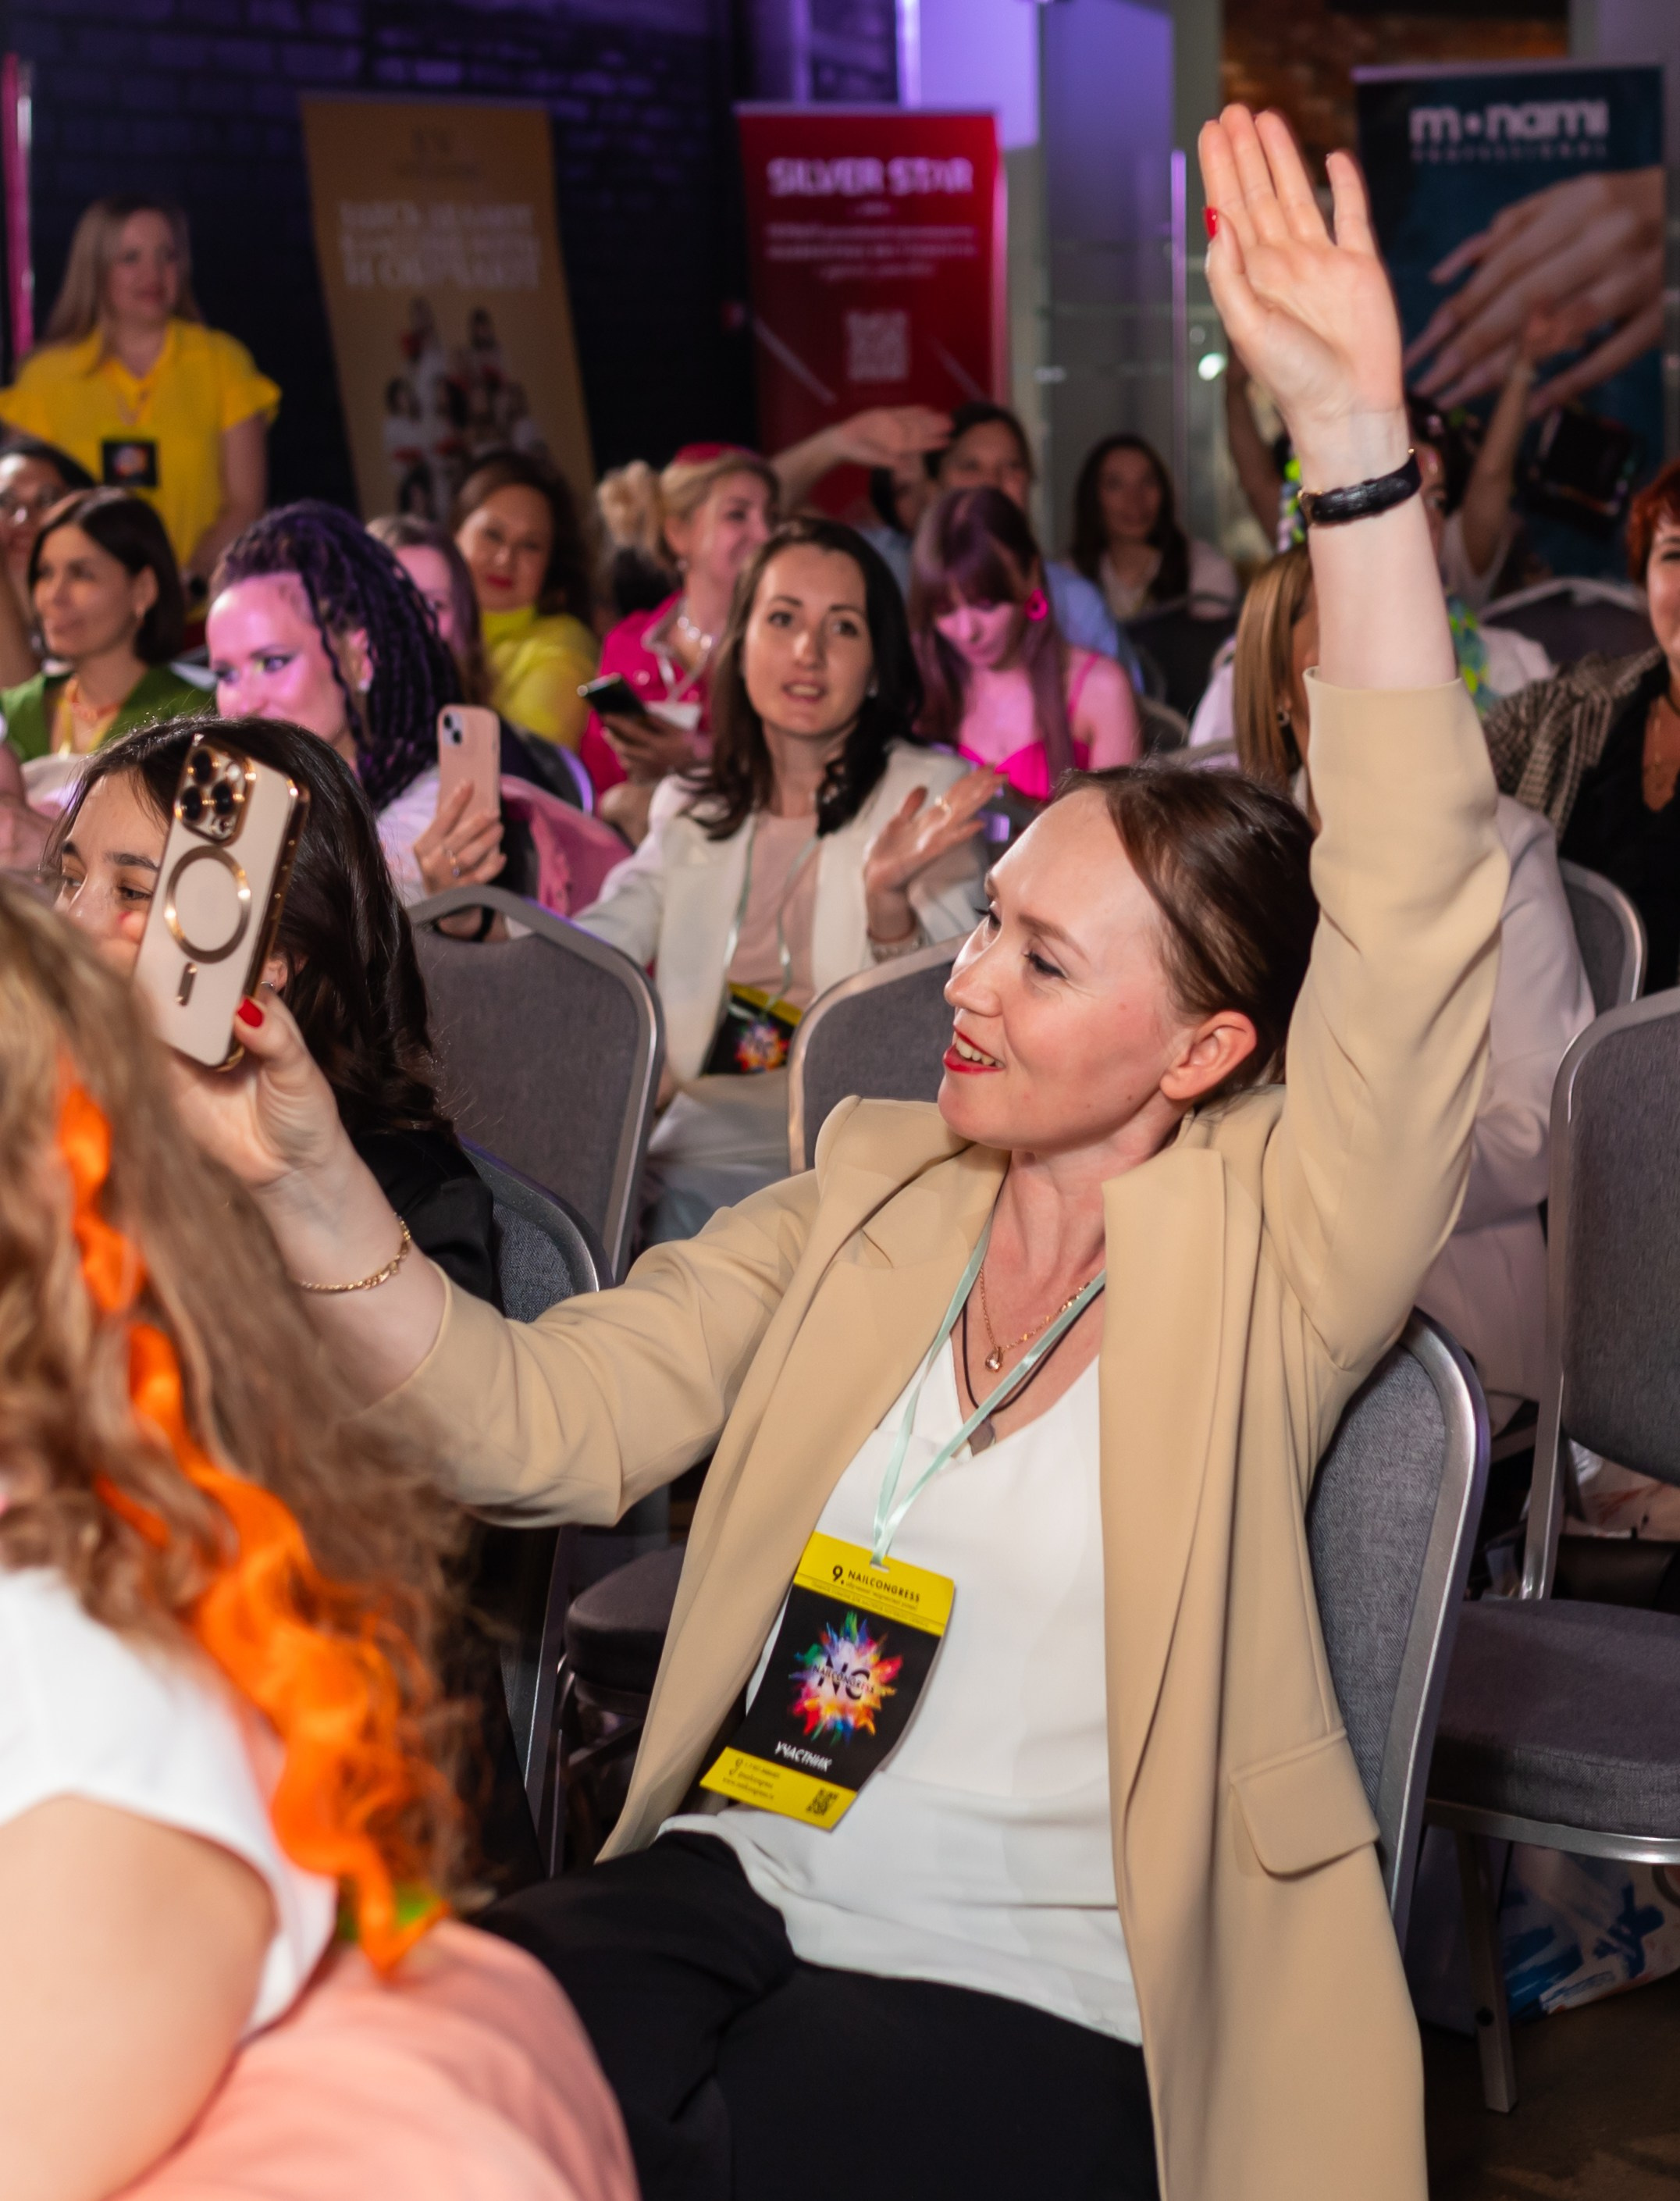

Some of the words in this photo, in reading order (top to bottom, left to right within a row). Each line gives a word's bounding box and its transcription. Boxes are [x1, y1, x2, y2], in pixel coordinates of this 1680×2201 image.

[766, 156, 884, 196] SILVER
[848, 1569, 920, 1604] NAILCONGRESS
[774, 1740, 832, 1772] УЧАСТНИК
